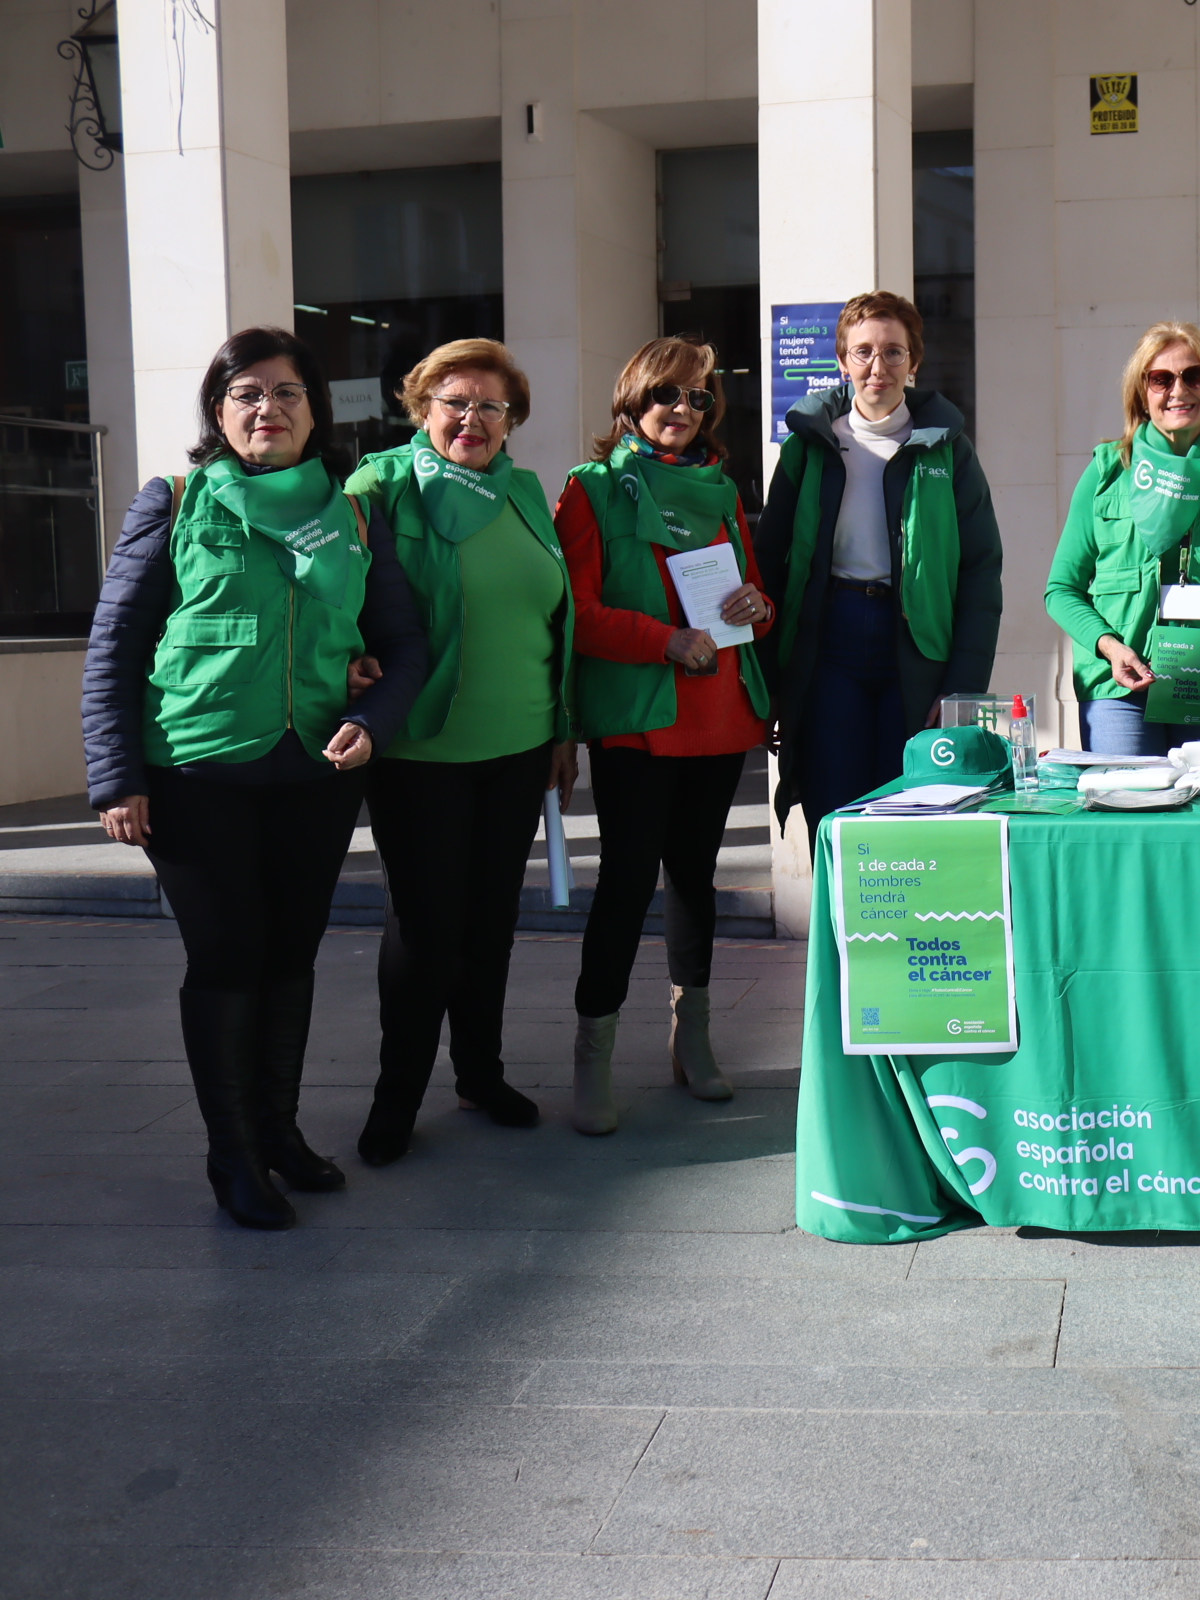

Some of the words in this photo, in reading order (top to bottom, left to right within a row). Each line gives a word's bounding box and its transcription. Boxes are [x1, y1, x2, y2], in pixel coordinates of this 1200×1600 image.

[1100, 81, 1128, 95] LEYSE
[1092, 109, 1136, 122] PROTEGIDO
[780, 316, 788, 325] Si
[799, 326, 820, 334] cada
[822, 327, 827, 335] 3
[780, 336, 814, 346] mujeres
[779, 346, 808, 355] tendrá
[779, 357, 809, 365] cáncer
[807, 376, 840, 386] Todas
[339, 394, 372, 404] SALIDA
[445, 463, 481, 482] española
[1158, 469, 1190, 483] asociación
[443, 471, 468, 485] contra
[468, 482, 475, 490] el
[474, 486, 496, 500] cáncer
[1156, 477, 1184, 491] española
[1155, 485, 1173, 497] contra
[284, 518, 321, 542] asociación
[666, 524, 691, 537] cáncer
[292, 528, 323, 548] española
[1175, 678, 1197, 686] Todos
[857, 843, 870, 855] Si
[858, 861, 865, 871] 1
[868, 859, 887, 871] de
[890, 858, 925, 871] cada
[929, 860, 937, 870] 2
[859, 875, 921, 887] hombres
[860, 891, 905, 903] tendrá
[860, 907, 908, 919] cáncer
[906, 937, 961, 951] Todos
[907, 953, 967, 966] contra
[908, 967, 926, 981] el
[929, 967, 992, 981] cáncer
[1014, 1104, 1152, 1131] asociación
[1016, 1137, 1134, 1168] española
[1019, 1171, 1098, 1196] contra
[1106, 1169, 1130, 1193] el
